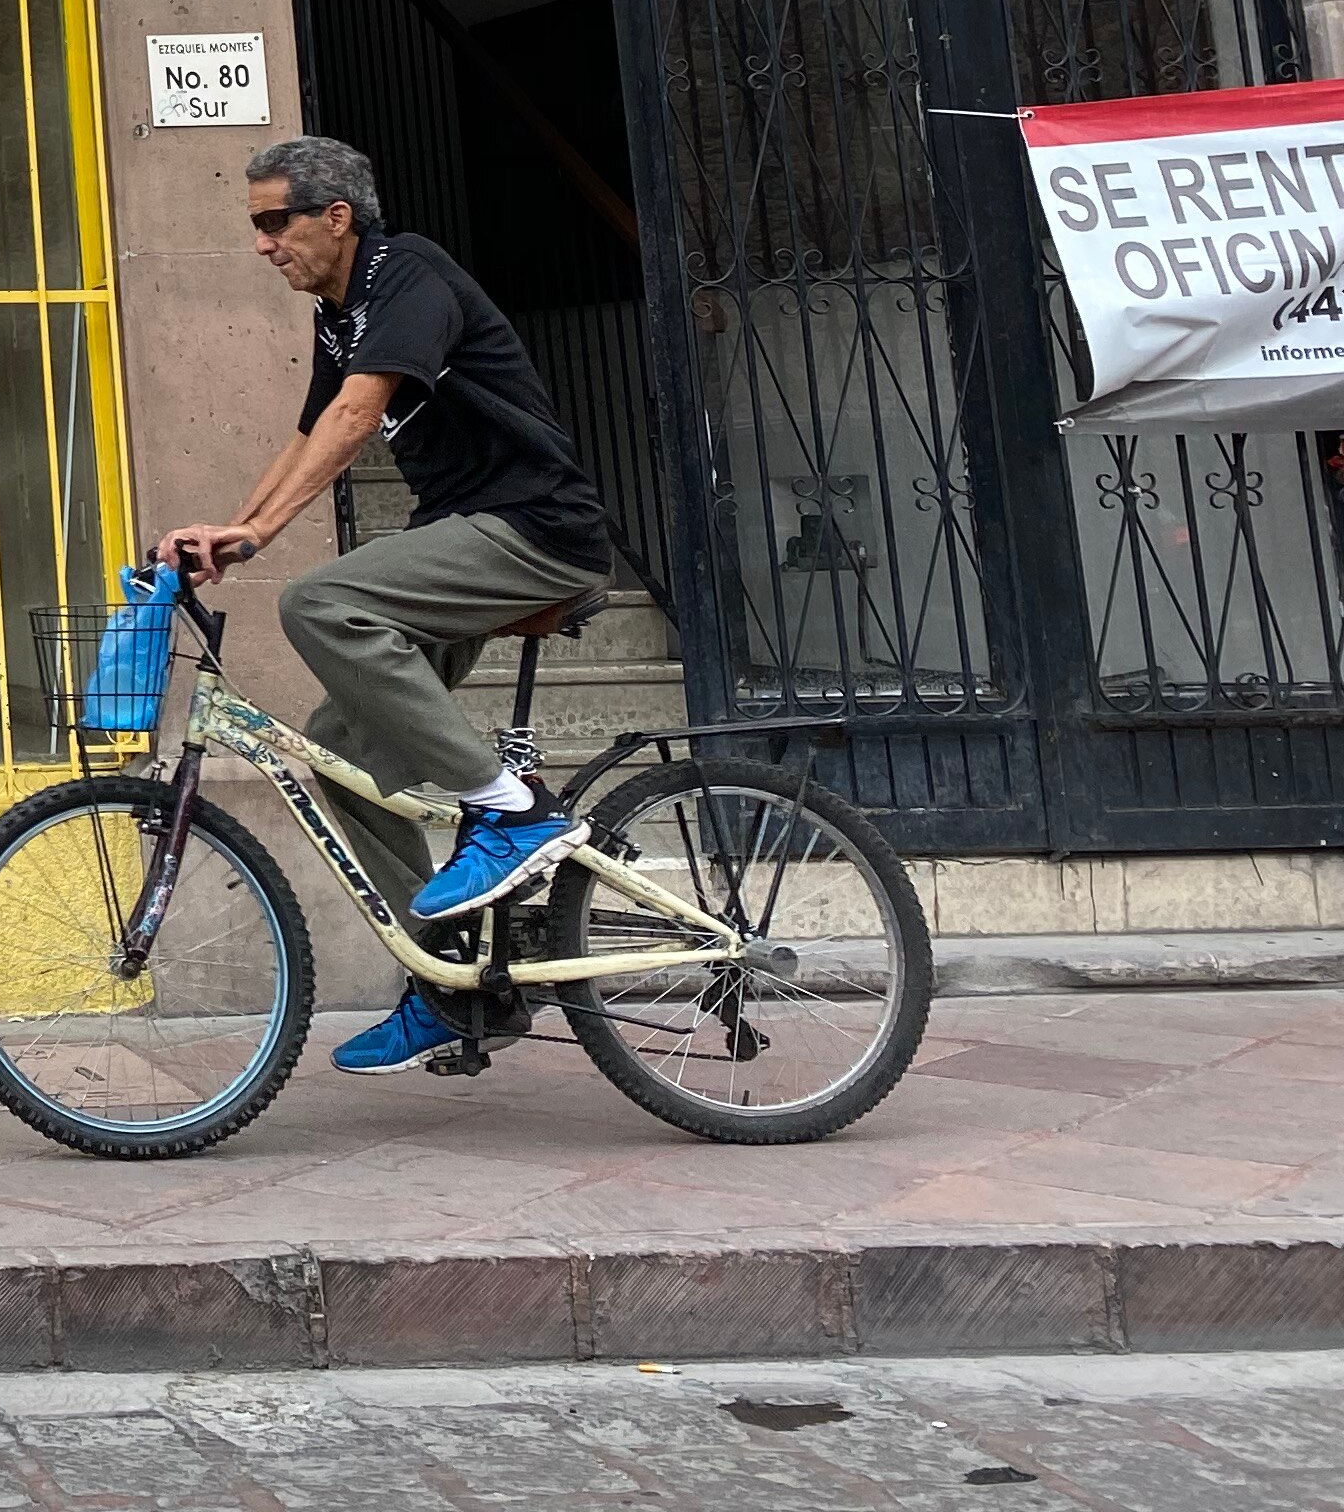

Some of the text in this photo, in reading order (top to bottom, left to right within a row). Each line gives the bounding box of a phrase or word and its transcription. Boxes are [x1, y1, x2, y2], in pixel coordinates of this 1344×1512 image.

[158, 42, 253, 54] EZEQUIEL MONTES
[165, 64, 250, 90] No. 80
[189, 96, 229, 118] Sur
[1048, 143, 1344, 232] SE RENT
[1115, 225, 1344, 300] OFICIN
[1273, 285, 1344, 331] (44
[1261, 344, 1344, 361] informe
